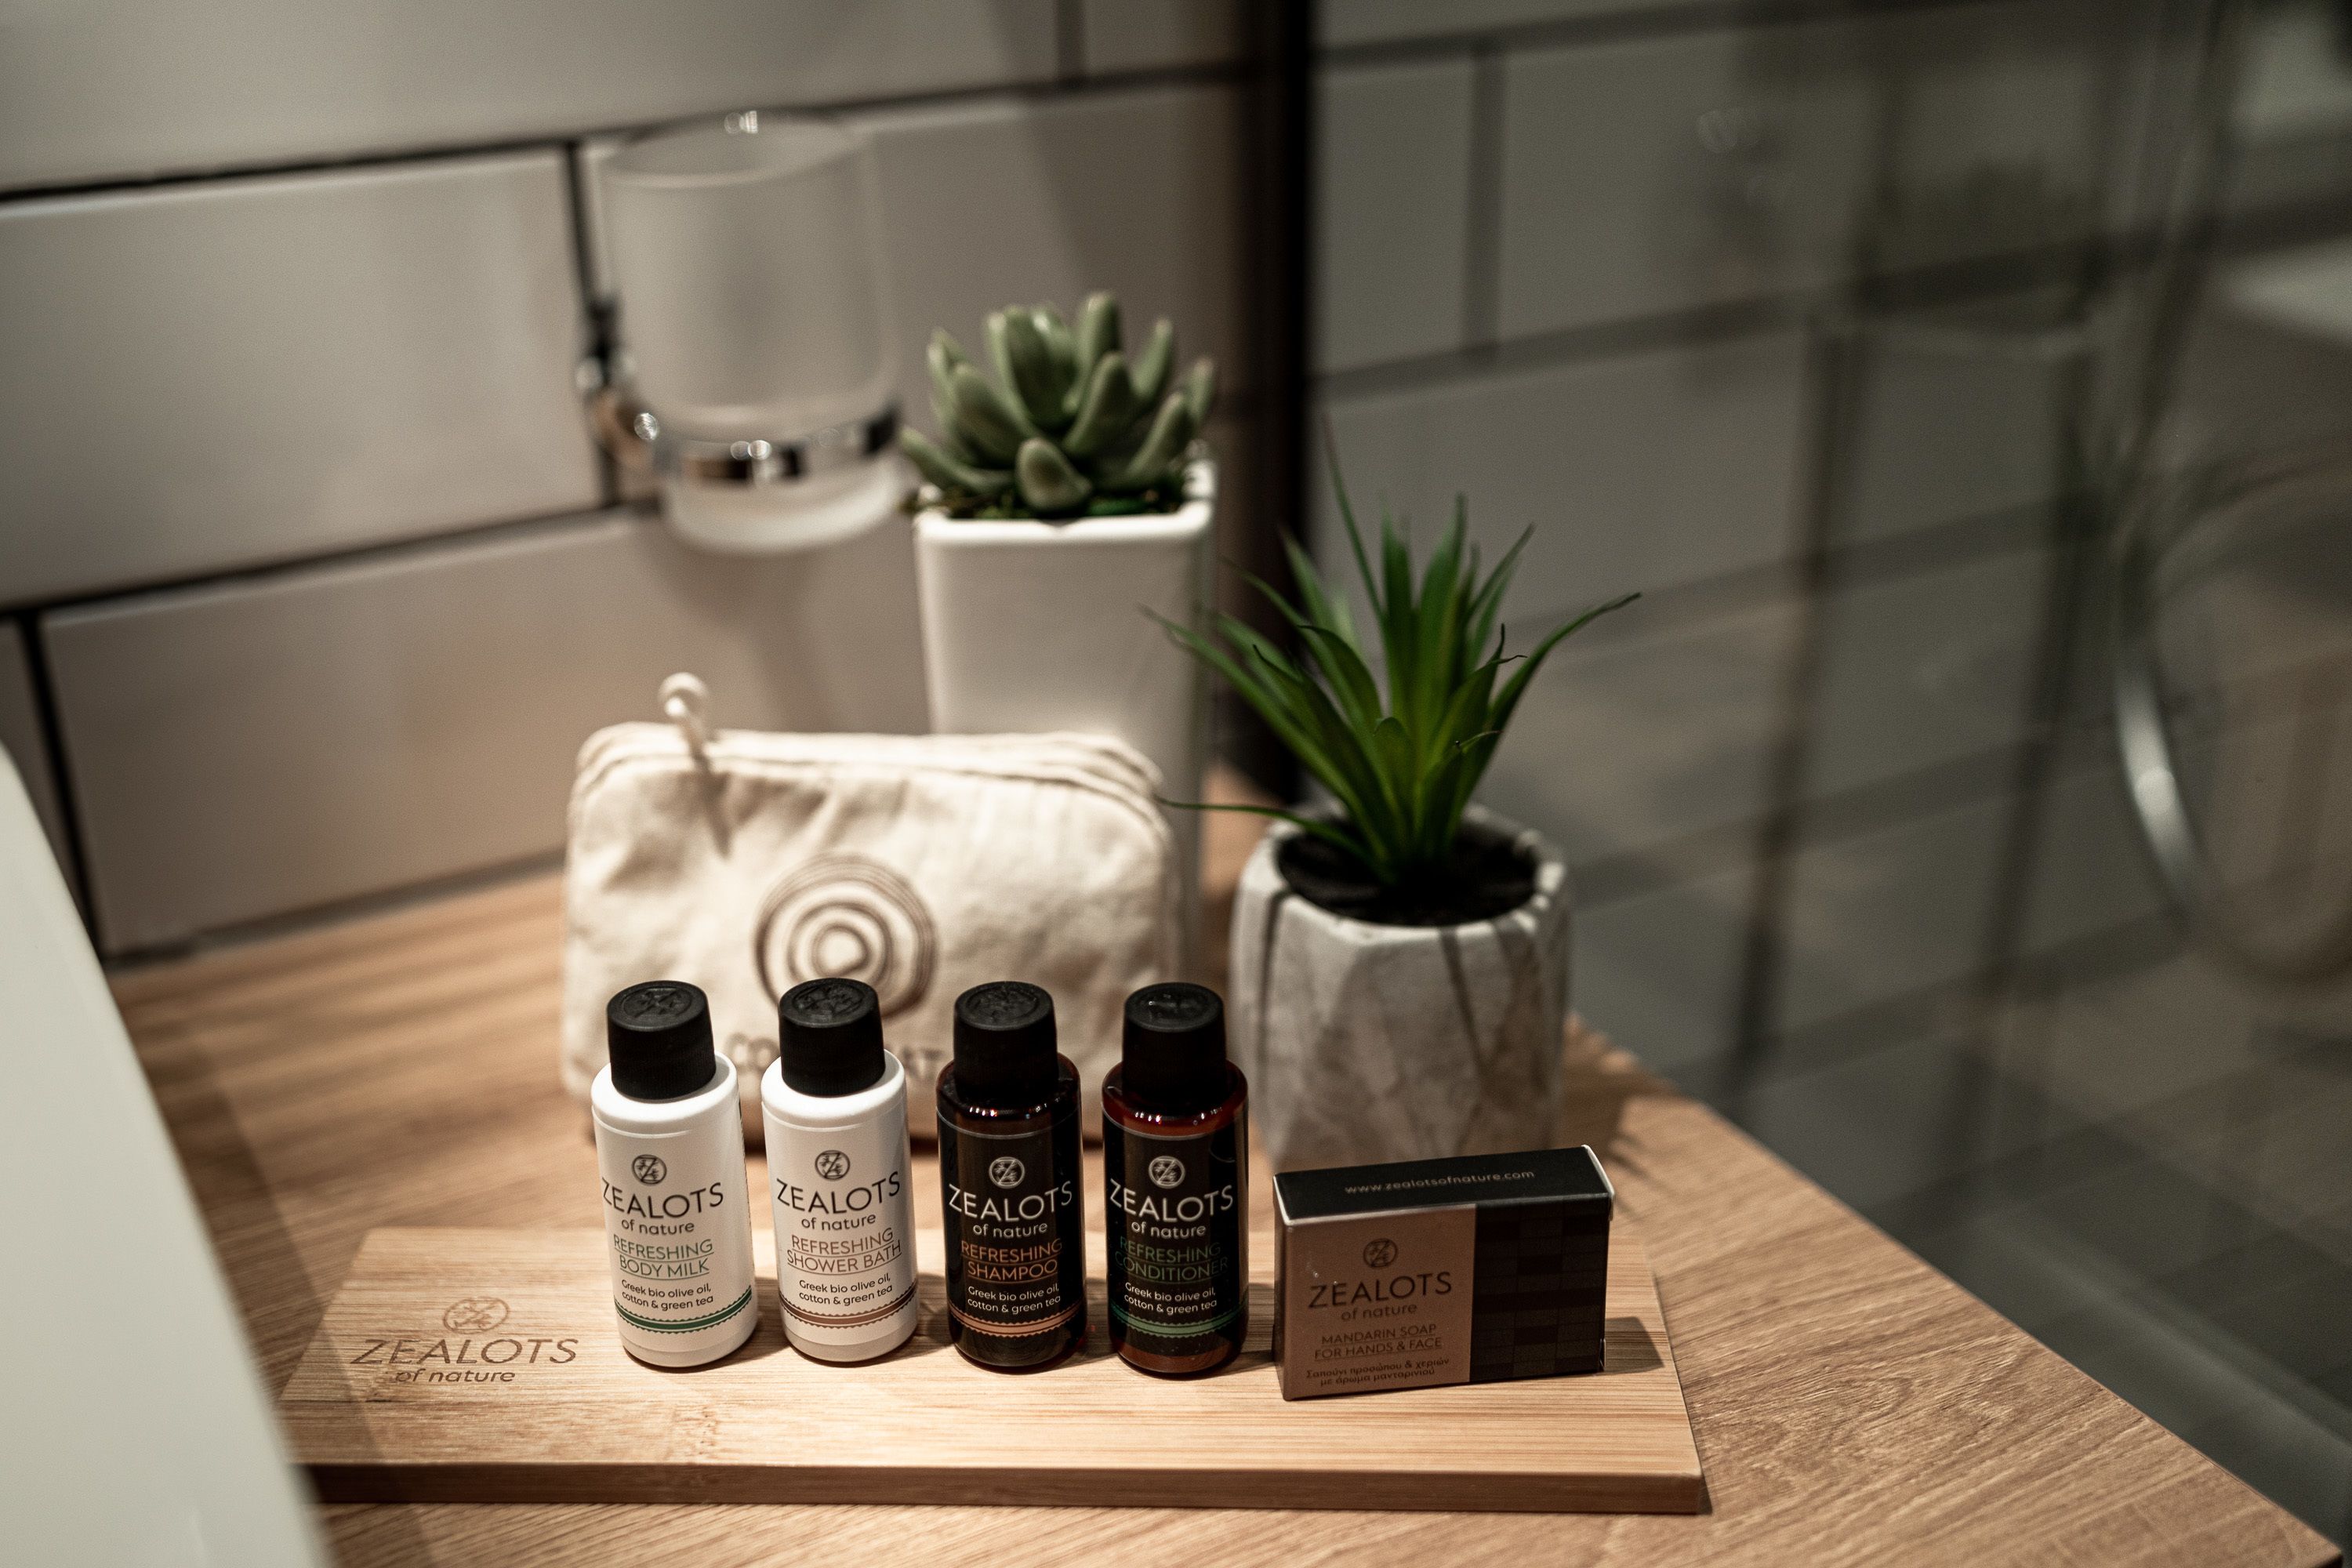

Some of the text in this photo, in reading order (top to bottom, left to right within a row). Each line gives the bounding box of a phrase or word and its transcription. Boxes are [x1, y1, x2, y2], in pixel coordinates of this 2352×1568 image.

[776, 1171, 900, 1214] ZEALOTS
[1345, 1171, 1535, 1194] www.zealotsofnature.com
[602, 1177, 724, 1219] ZEALOTS
[949, 1181, 1073, 1222] ZEALOTS
[1110, 1178, 1233, 1223] ZEALOTS
[622, 1219, 695, 1236] of nature
[801, 1214, 876, 1231] of nature
[973, 1223, 1047, 1239] of nature
[1131, 1221, 1206, 1239] of nature
[614, 1234, 713, 1260] REFRESHING
[792, 1228, 893, 1254] REFRESHING
[961, 1238, 1062, 1262] REFRESHING
[1120, 1236, 1221, 1263] REFRESHING
[619, 1254, 709, 1277] BODY MILK
[787, 1240, 901, 1272] SHOWER BATH
[1116, 1251, 1228, 1281] CONDITIONER
[967, 1259, 1058, 1280] SHAMPOO
[622, 1279, 711, 1298] Greek bio olive oil,
[799, 1273, 891, 1293] Greek bio olive oil,
[968, 1287, 996, 1300] Greek
[1000, 1293, 1016, 1301] bio
[1019, 1290, 1044, 1301] olive
[1125, 1282, 1152, 1298] Greek
[1155, 1291, 1171, 1301] bio
[1174, 1292, 1200, 1301] olive
[1308, 1272, 1451, 1308] ZEALOTS
[622, 1291, 713, 1311] cotton & green tea
[799, 1292, 830, 1305] cotton
[843, 1293, 874, 1306] green
[877, 1285, 892, 1297] tea
[967, 1298, 998, 1312] cotton
[1011, 1302, 1043, 1315] green
[1046, 1295, 1061, 1305] tea
[1124, 1294, 1217, 1316] cotton & green tea
[1341, 1304, 1417, 1321] of nature
[1322, 1323, 1436, 1345] MANDARIN SOAP
[350, 1338, 579, 1364] ZEALOTS
[1315, 1337, 1441, 1359] FOR HANDS & FACE
[1416, 1357, 1450, 1369] χεριών
[395, 1368, 515, 1382] of nature
